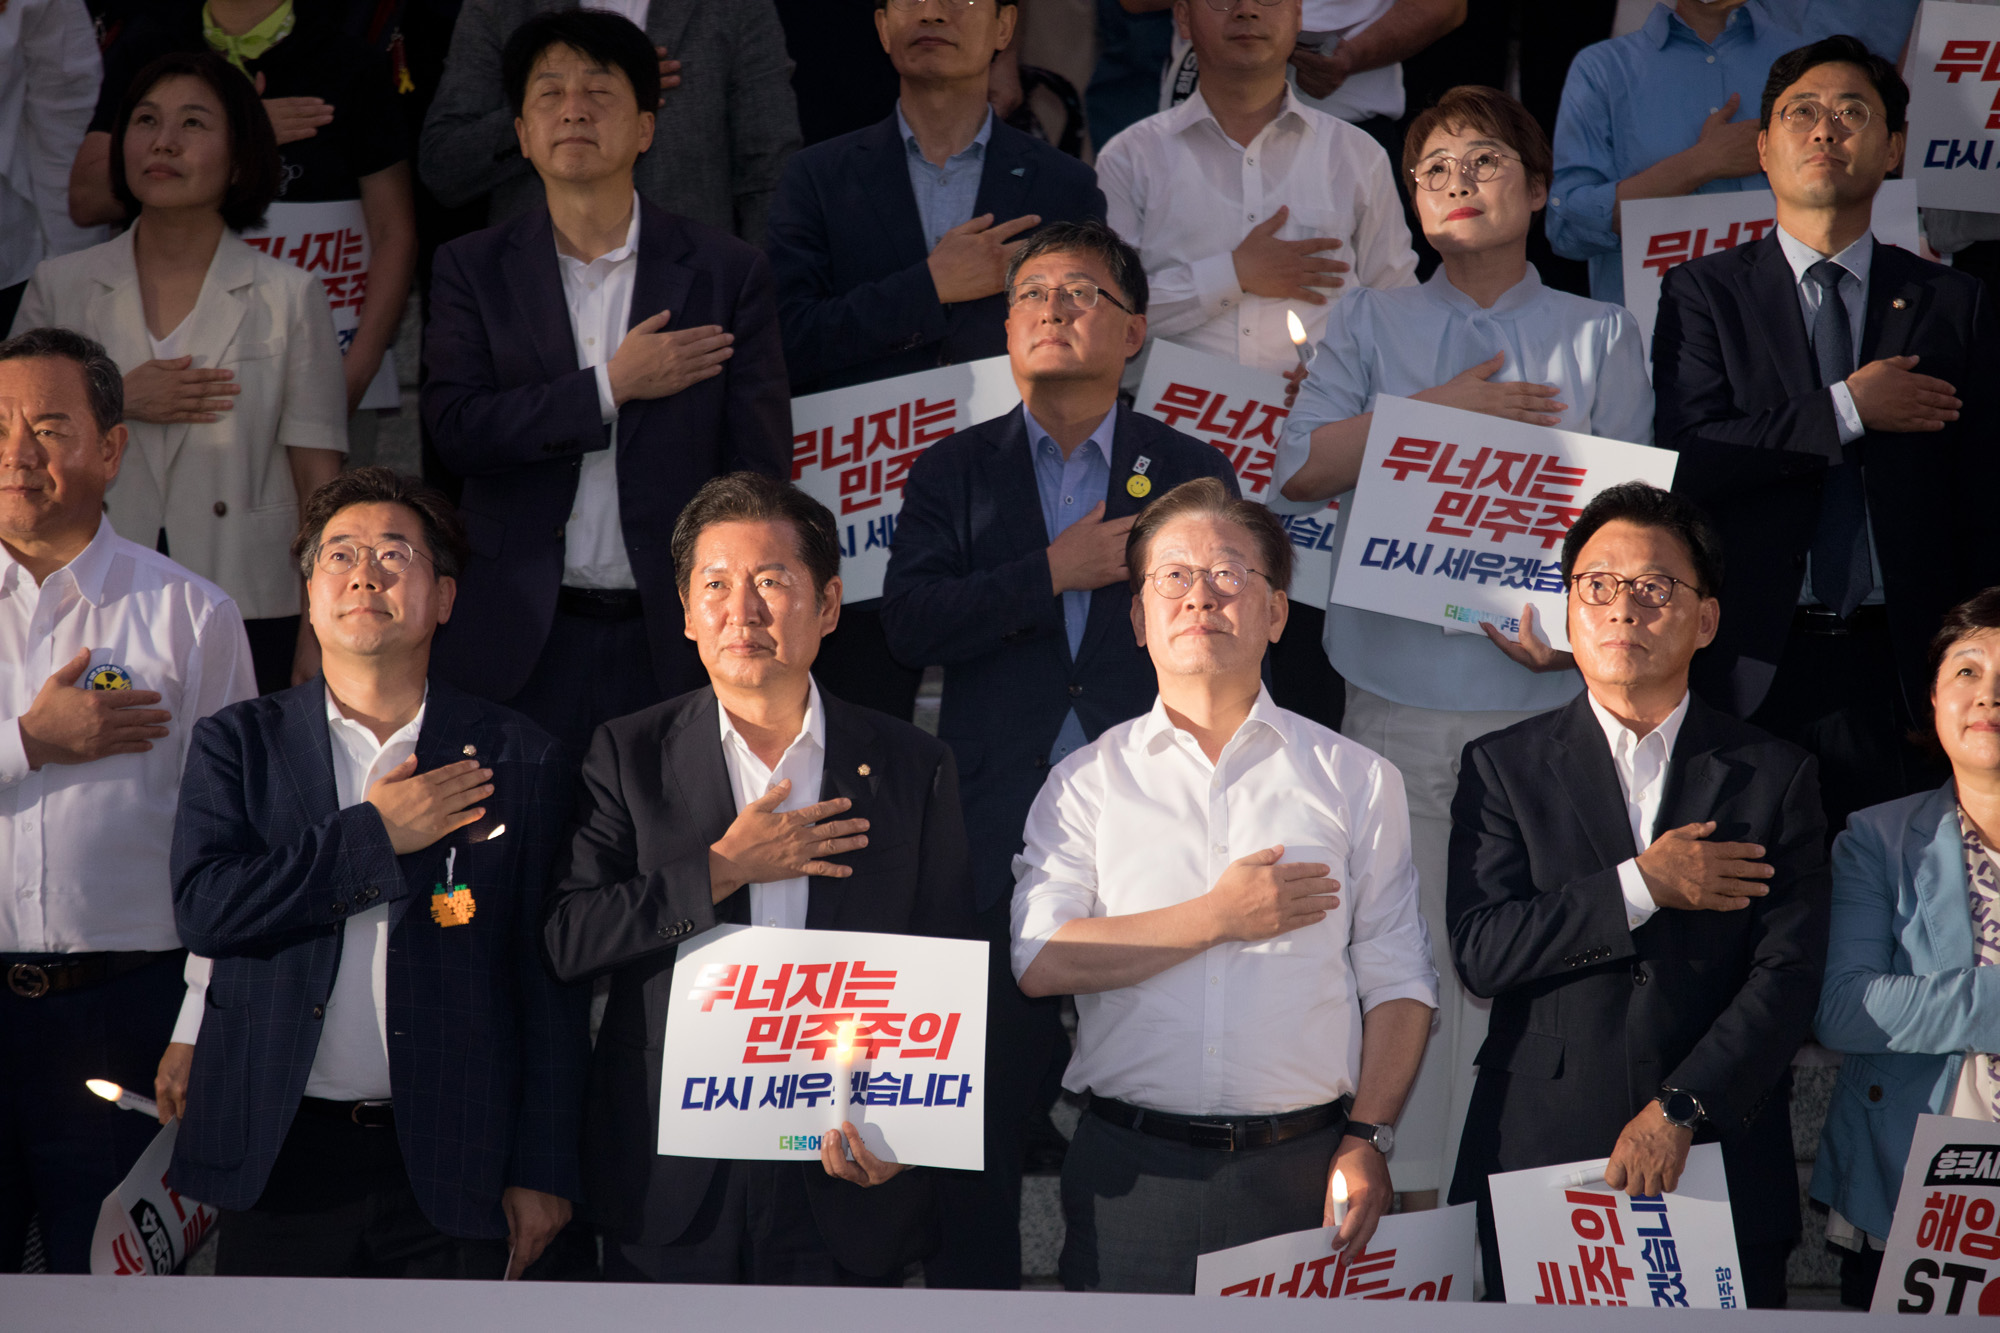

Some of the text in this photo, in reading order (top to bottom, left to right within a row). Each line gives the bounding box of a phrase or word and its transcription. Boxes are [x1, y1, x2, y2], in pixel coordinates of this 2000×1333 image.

[1923, 139, 1994, 170] 다시
[1381, 436, 1588, 503] 무너지는
[1426, 490, 1582, 550] 민주주
[1359, 537, 1569, 595] 다시 세우겠습
[687, 961, 898, 1012] 무너지는
[742, 1013, 961, 1064] 민주주의
[681, 1075, 755, 1112] 다시
